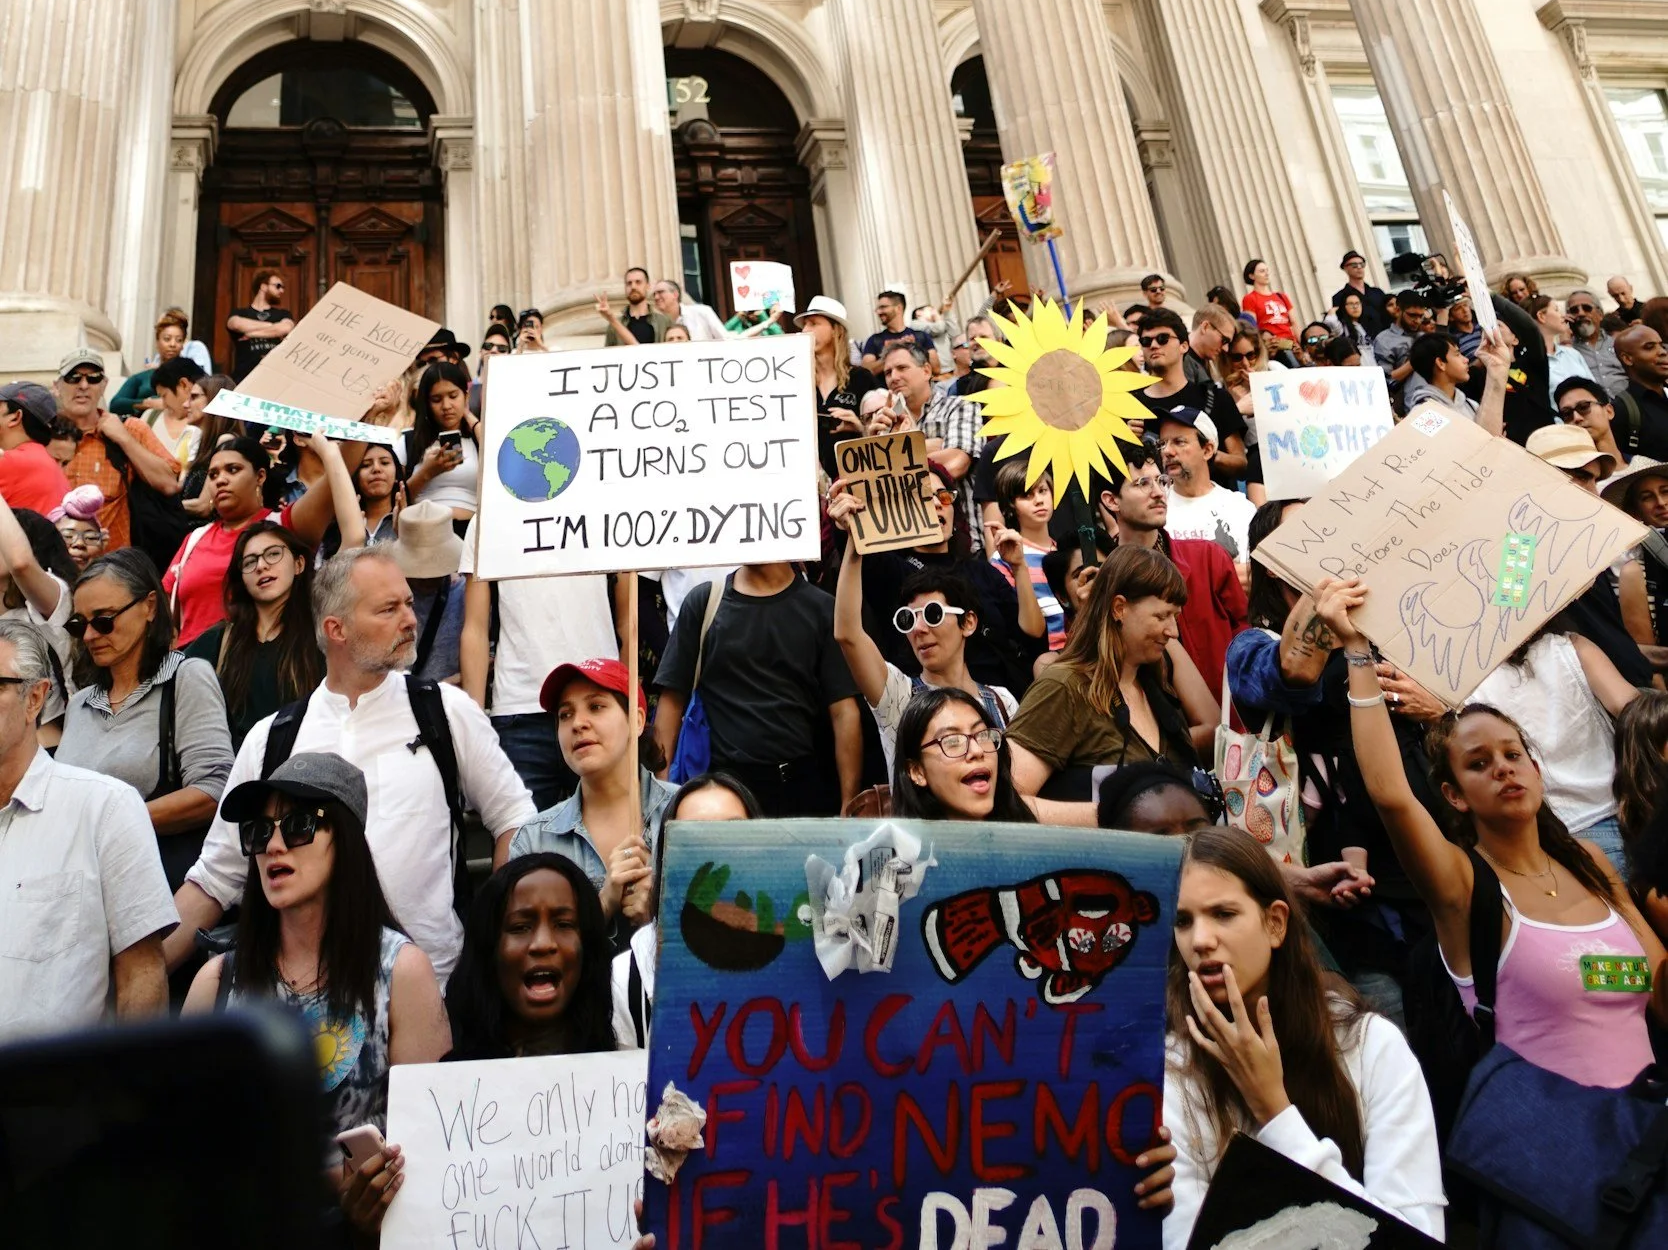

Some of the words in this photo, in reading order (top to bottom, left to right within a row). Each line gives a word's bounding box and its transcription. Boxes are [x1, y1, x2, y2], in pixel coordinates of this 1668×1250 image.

[675, 78, 711, 103] 52
[324, 303, 363, 330] THE
[285, 342, 330, 378] KILL
[316, 330, 337, 349] are
[342, 343, 380, 365] gonna
[549, 366, 581, 396] I
[591, 360, 683, 393] JUST
[698, 356, 796, 384] TOOK
[1264, 383, 1289, 412] I
[1339, 379, 1375, 406] MY
[589, 403, 618, 432] A
[698, 394, 797, 424] TEST
[587, 443, 707, 481] TURNS
[723, 439, 799, 470] OUT
[842, 438, 894, 474] ONLY
[901, 434, 923, 471] 1
[846, 470, 939, 540] FUTURE
[1276, 520, 1337, 554] We
[1329, 475, 1384, 516] Must
[1381, 447, 1426, 475] Rise
[1319, 534, 1404, 580] Before
[1385, 499, 1441, 529] The
[1421, 460, 1493, 501] Tide
[523, 514, 589, 553] I'M
[603, 509, 679, 547] 100%
[688, 499, 806, 544] DYING
[1401, 541, 1459, 572] Does
[1505, 537, 1520, 573] NATURE
[1517, 538, 1531, 569] AGAIN
[1501, 576, 1513, 602] MAKE
[1512, 573, 1524, 603] GREAT
[1583, 961, 1612, 972] MAKE
[1615, 961, 1648, 972] NATURE
[1586, 974, 1618, 985] GREAT
[1623, 975, 1650, 986] AGAIN
[686, 996, 846, 1081] YOU
[864, 993, 1105, 1081] CAN'T
[428, 1078, 512, 1152] We
[527, 1072, 596, 1136] only
[705, 1079, 872, 1160] FIND
[892, 1078, 1163, 1187] NEMO
[442, 1157, 500, 1210] one
[513, 1136, 581, 1190] world
[599, 1125, 645, 1171] don't
[552, 1189, 593, 1250] IT
[666, 1169, 753, 1250] IF
[918, 1186, 1117, 1250] DEAD
